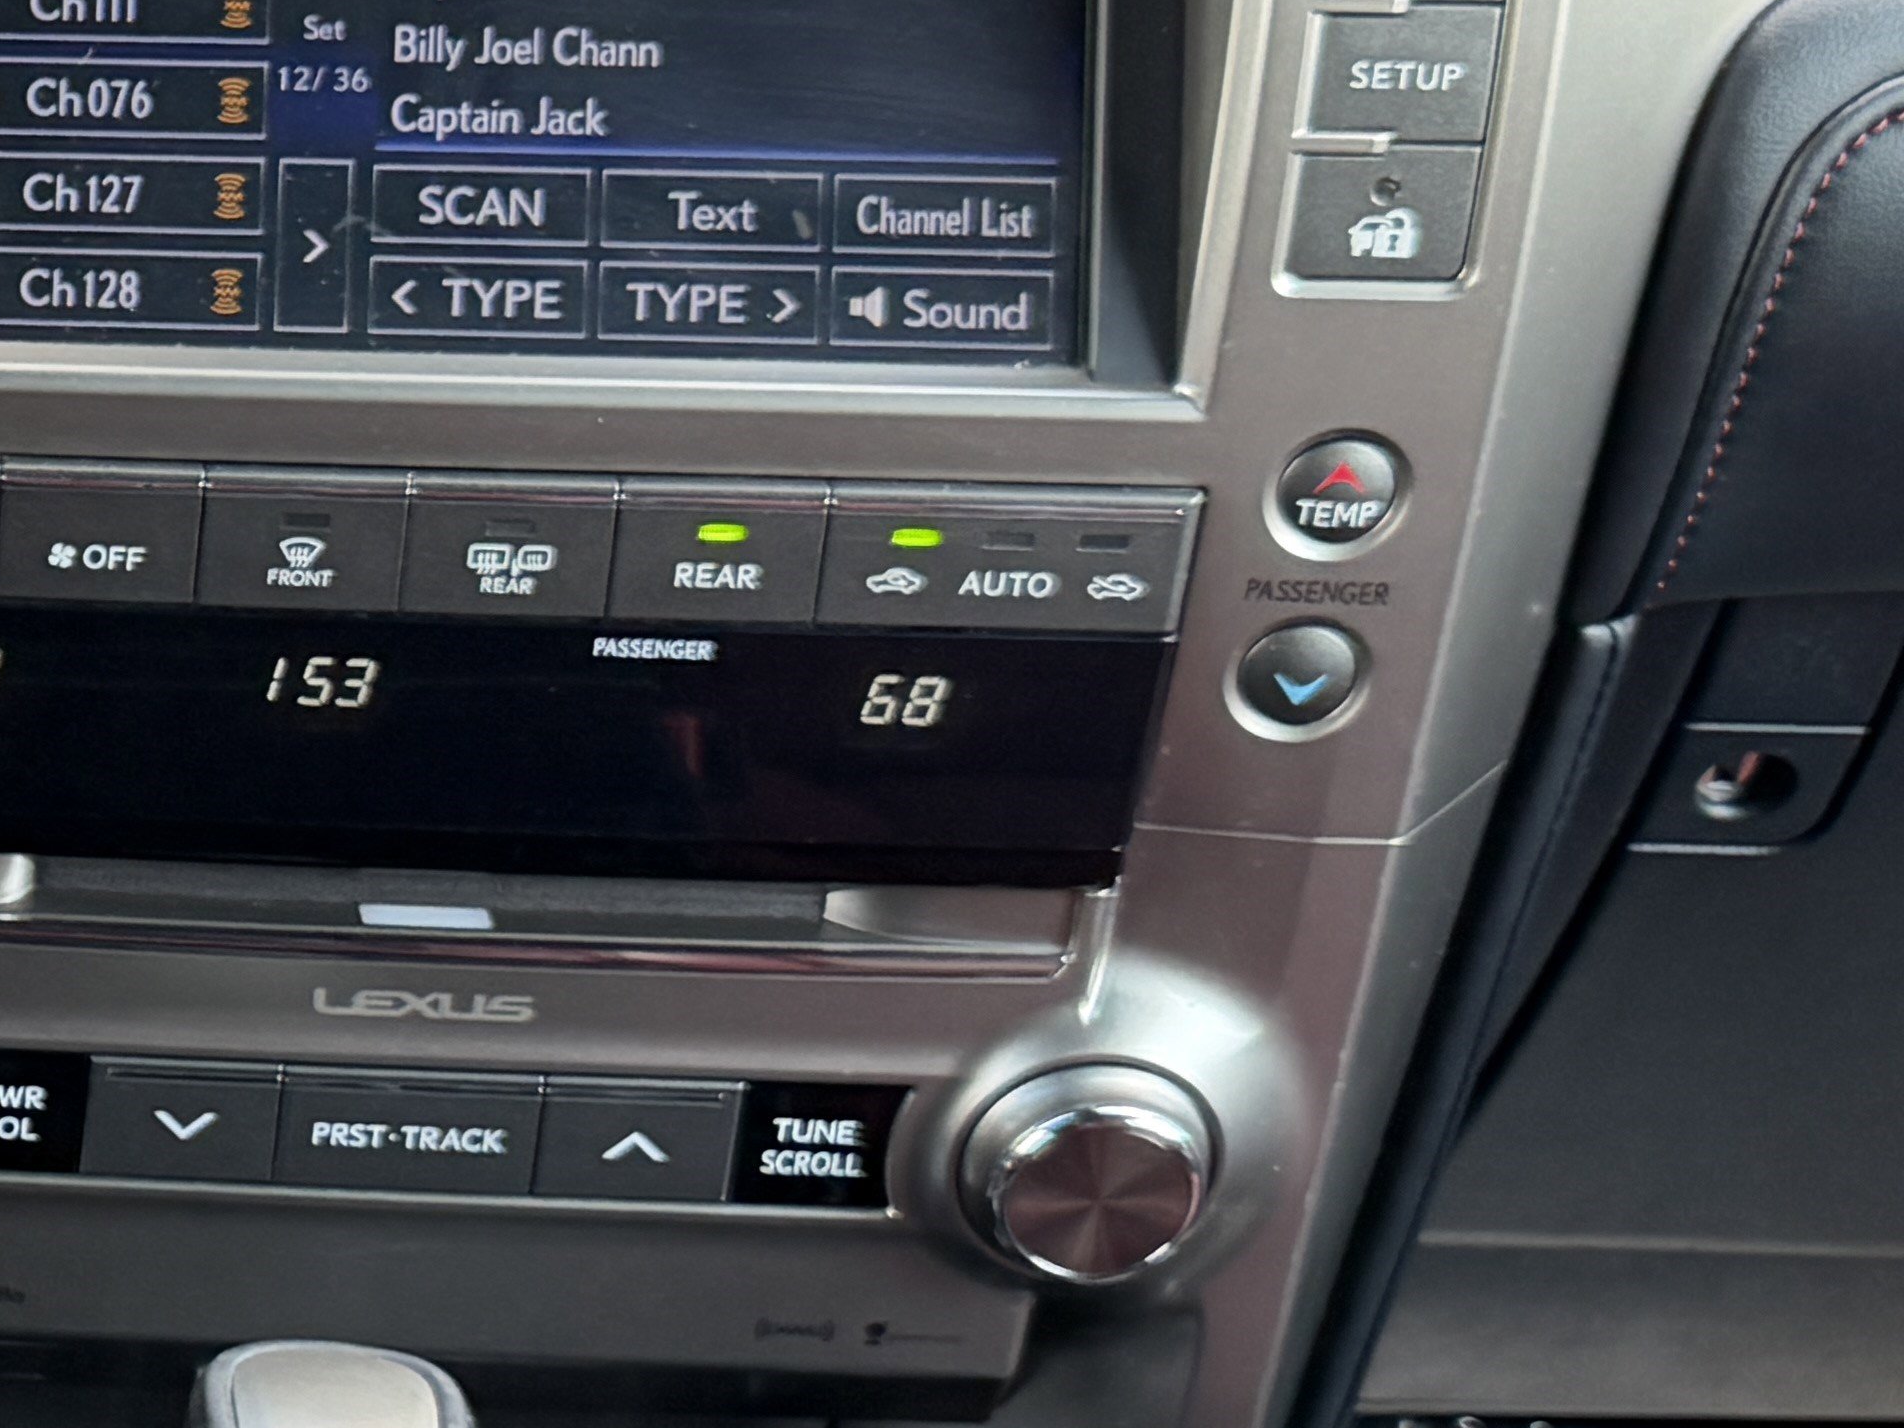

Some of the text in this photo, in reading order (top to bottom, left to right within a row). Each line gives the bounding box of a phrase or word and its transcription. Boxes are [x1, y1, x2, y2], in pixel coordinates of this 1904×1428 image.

[303, 15, 346, 42] Set
[393, 23, 664, 72] Billy Joel Chann
[1349, 59, 1466, 92] SETUP
[391, 92, 610, 142] Captain Jack
[418, 184, 546, 227] SCAN
[668, 190, 760, 233] Text
[856, 195, 1034, 239] Channel List
[442, 277, 565, 320] TYPE
[625, 282, 751, 325] TYPE
[903, 289, 1030, 332] Sound
[1296, 499, 1383, 528] TEMP
[82, 544, 149, 571] OFF
[266, 567, 334, 588] FRONT
[478, 576, 537, 596] REAR
[673, 563, 763, 591] REAR
[958, 571, 1057, 598] AUTO
[1244, 577, 1389, 606] PASSENGER
[592, 637, 717, 662] PASSENGER
[859, 674, 953, 727] 68
[313, 987, 537, 1022] LEXUS
[772, 1117, 864, 1148] TUNE
[760, 1150, 865, 1179] SCROLL
